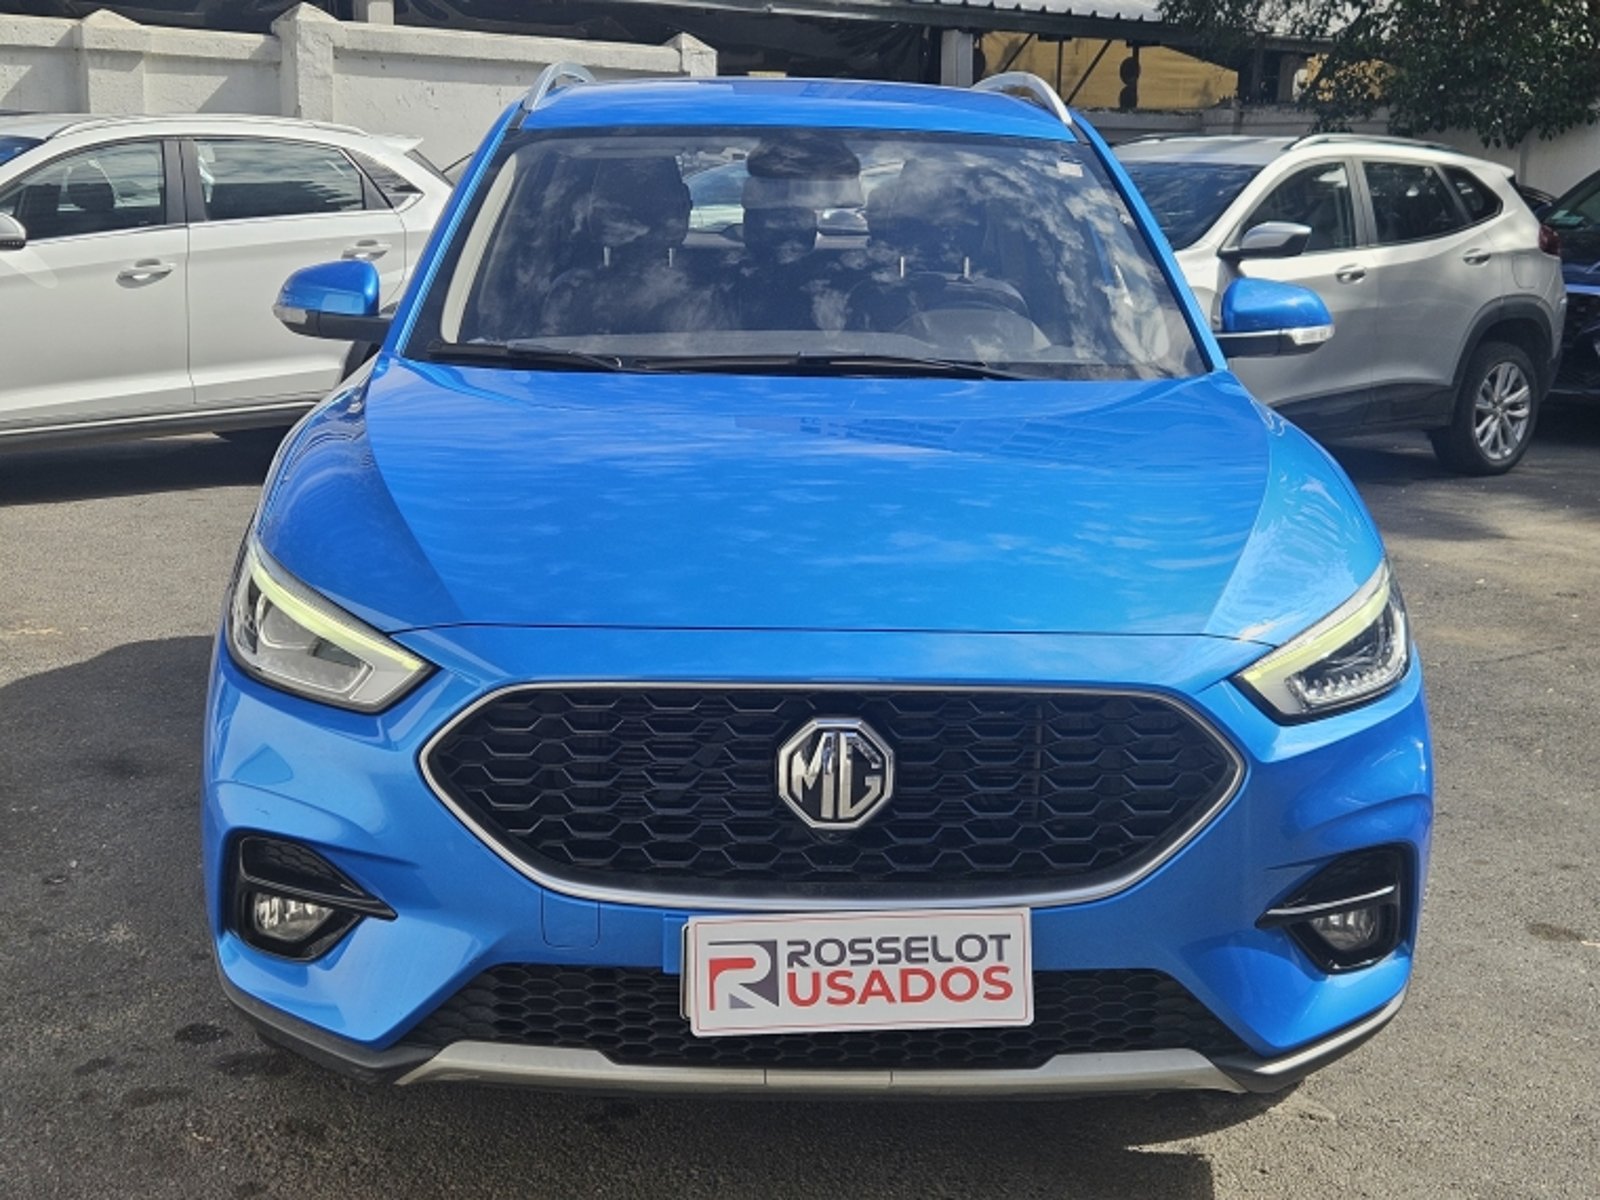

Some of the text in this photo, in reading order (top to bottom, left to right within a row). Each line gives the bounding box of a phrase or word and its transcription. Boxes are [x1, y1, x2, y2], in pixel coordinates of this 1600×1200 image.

[791, 732, 882, 819] MG
[787, 934, 1011, 968] ROSSELOT
[787, 966, 1013, 1007] USADOS
